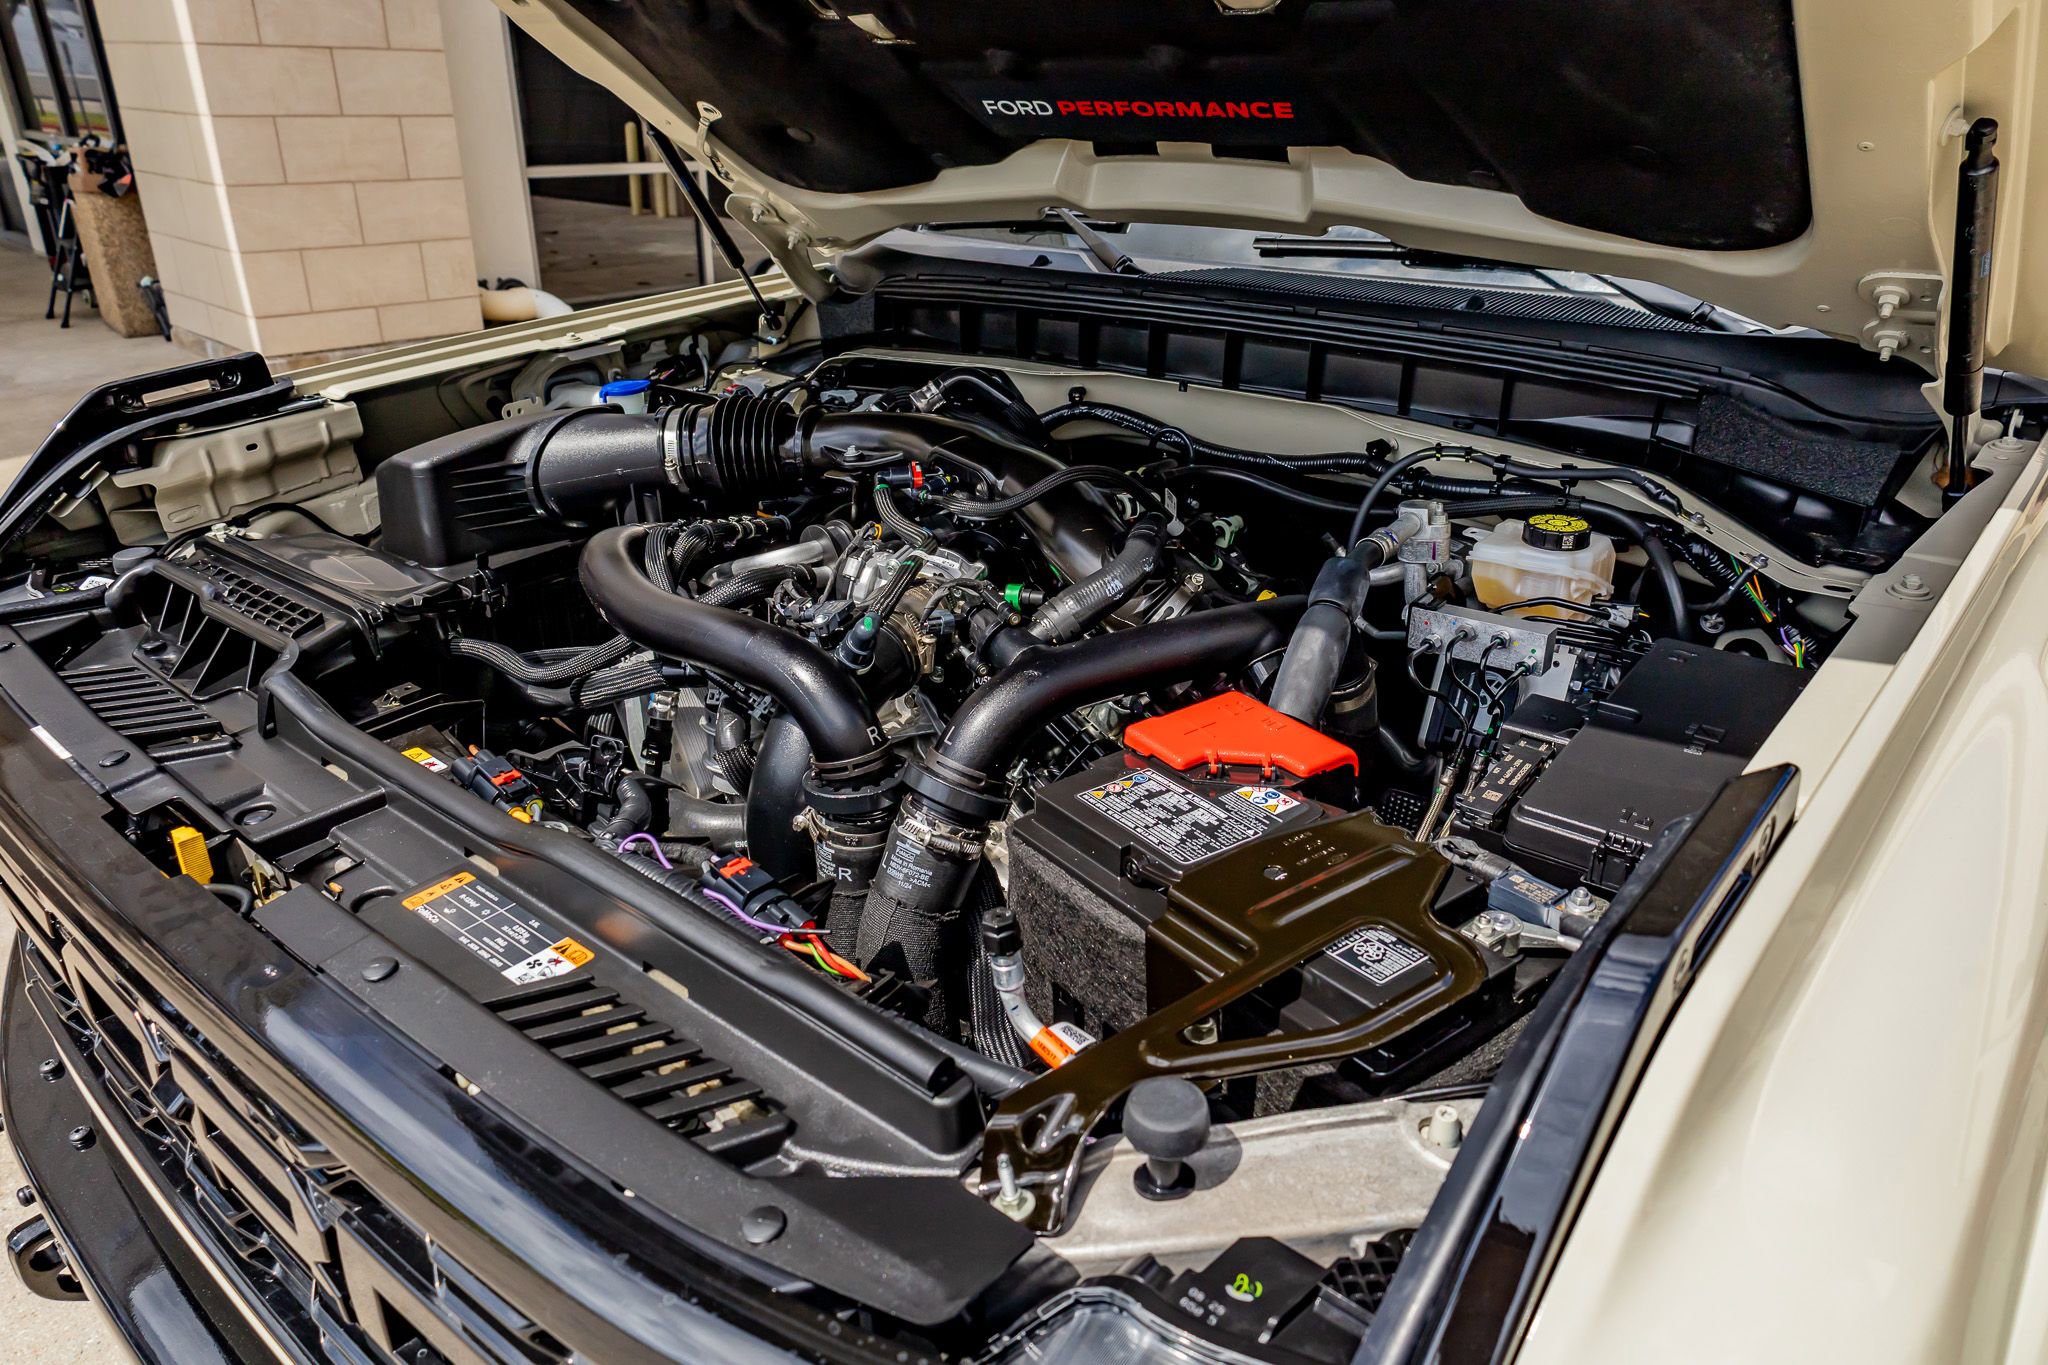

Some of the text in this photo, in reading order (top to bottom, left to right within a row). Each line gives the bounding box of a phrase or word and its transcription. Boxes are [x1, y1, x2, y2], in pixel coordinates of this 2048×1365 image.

[982, 100, 1295, 118] FORD PERFORMANCE
[866, 726, 882, 746] R
[944, 726, 956, 745] L
[838, 867, 852, 882] R
[908, 863, 933, 876] Romania
[415, 905, 439, 924] FoMoCo
